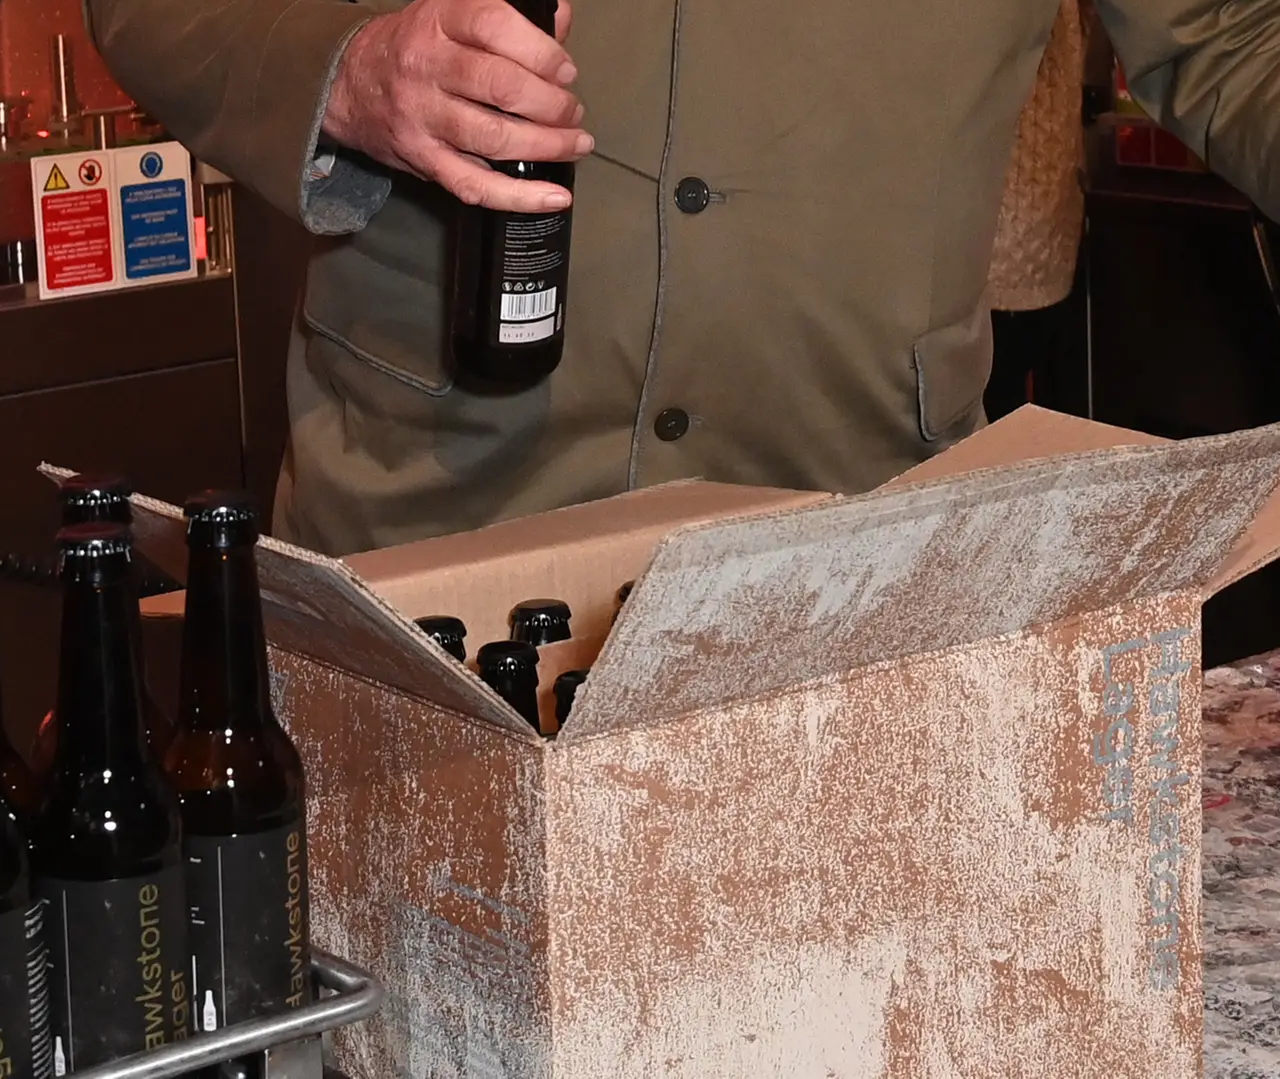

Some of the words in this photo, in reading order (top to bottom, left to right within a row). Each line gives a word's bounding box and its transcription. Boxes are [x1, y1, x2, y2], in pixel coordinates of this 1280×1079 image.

[1093, 638, 1148, 825] Lager
[1147, 627, 1193, 993] Hawkstone
[133, 883, 166, 1052] awkstone
